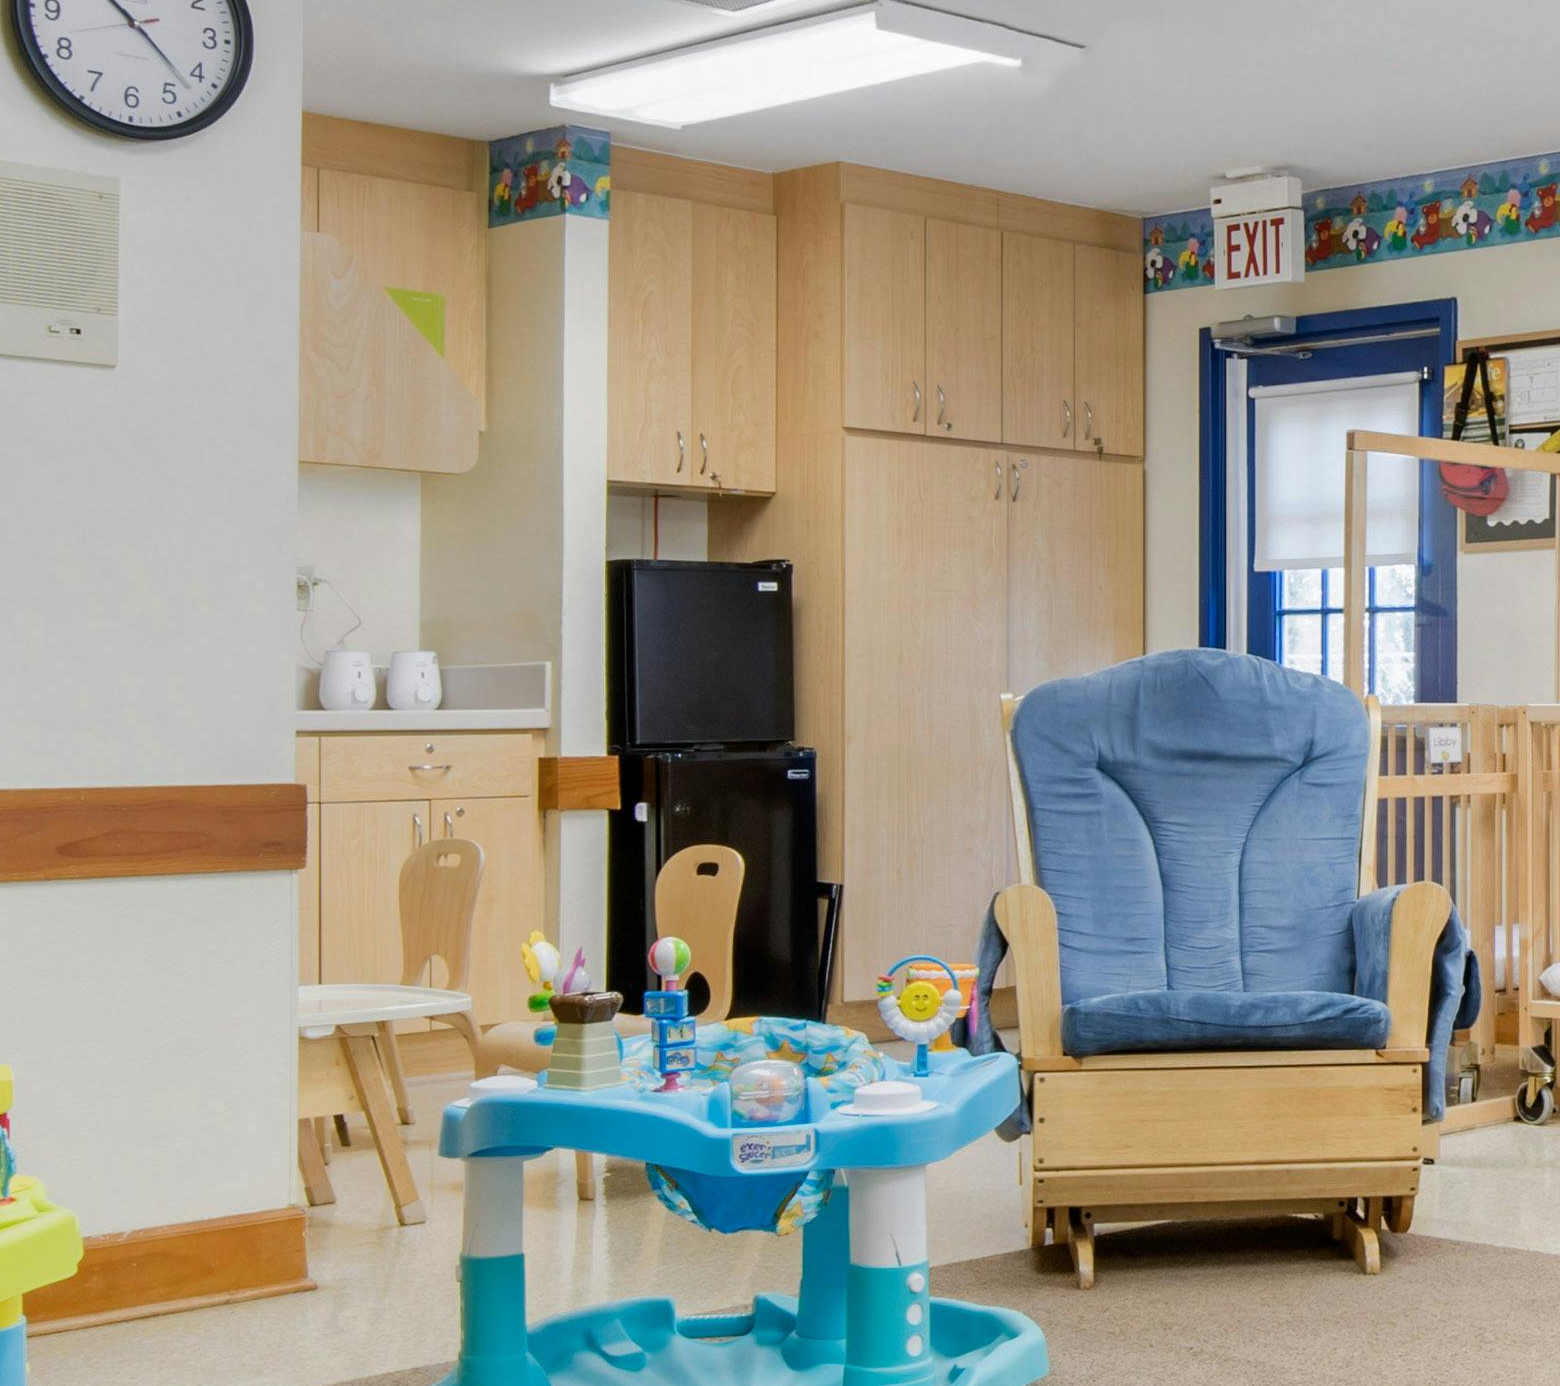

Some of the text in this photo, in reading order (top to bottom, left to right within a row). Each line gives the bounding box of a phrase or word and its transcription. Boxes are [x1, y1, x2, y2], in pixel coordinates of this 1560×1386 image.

[56, 37, 73, 60] 8
[202, 28, 217, 49] 3
[87, 70, 103, 92] 7
[190, 63, 205, 83] 4
[124, 86, 140, 108] 6
[162, 83, 177, 104] 5
[1226, 217, 1284, 280] EXIT
